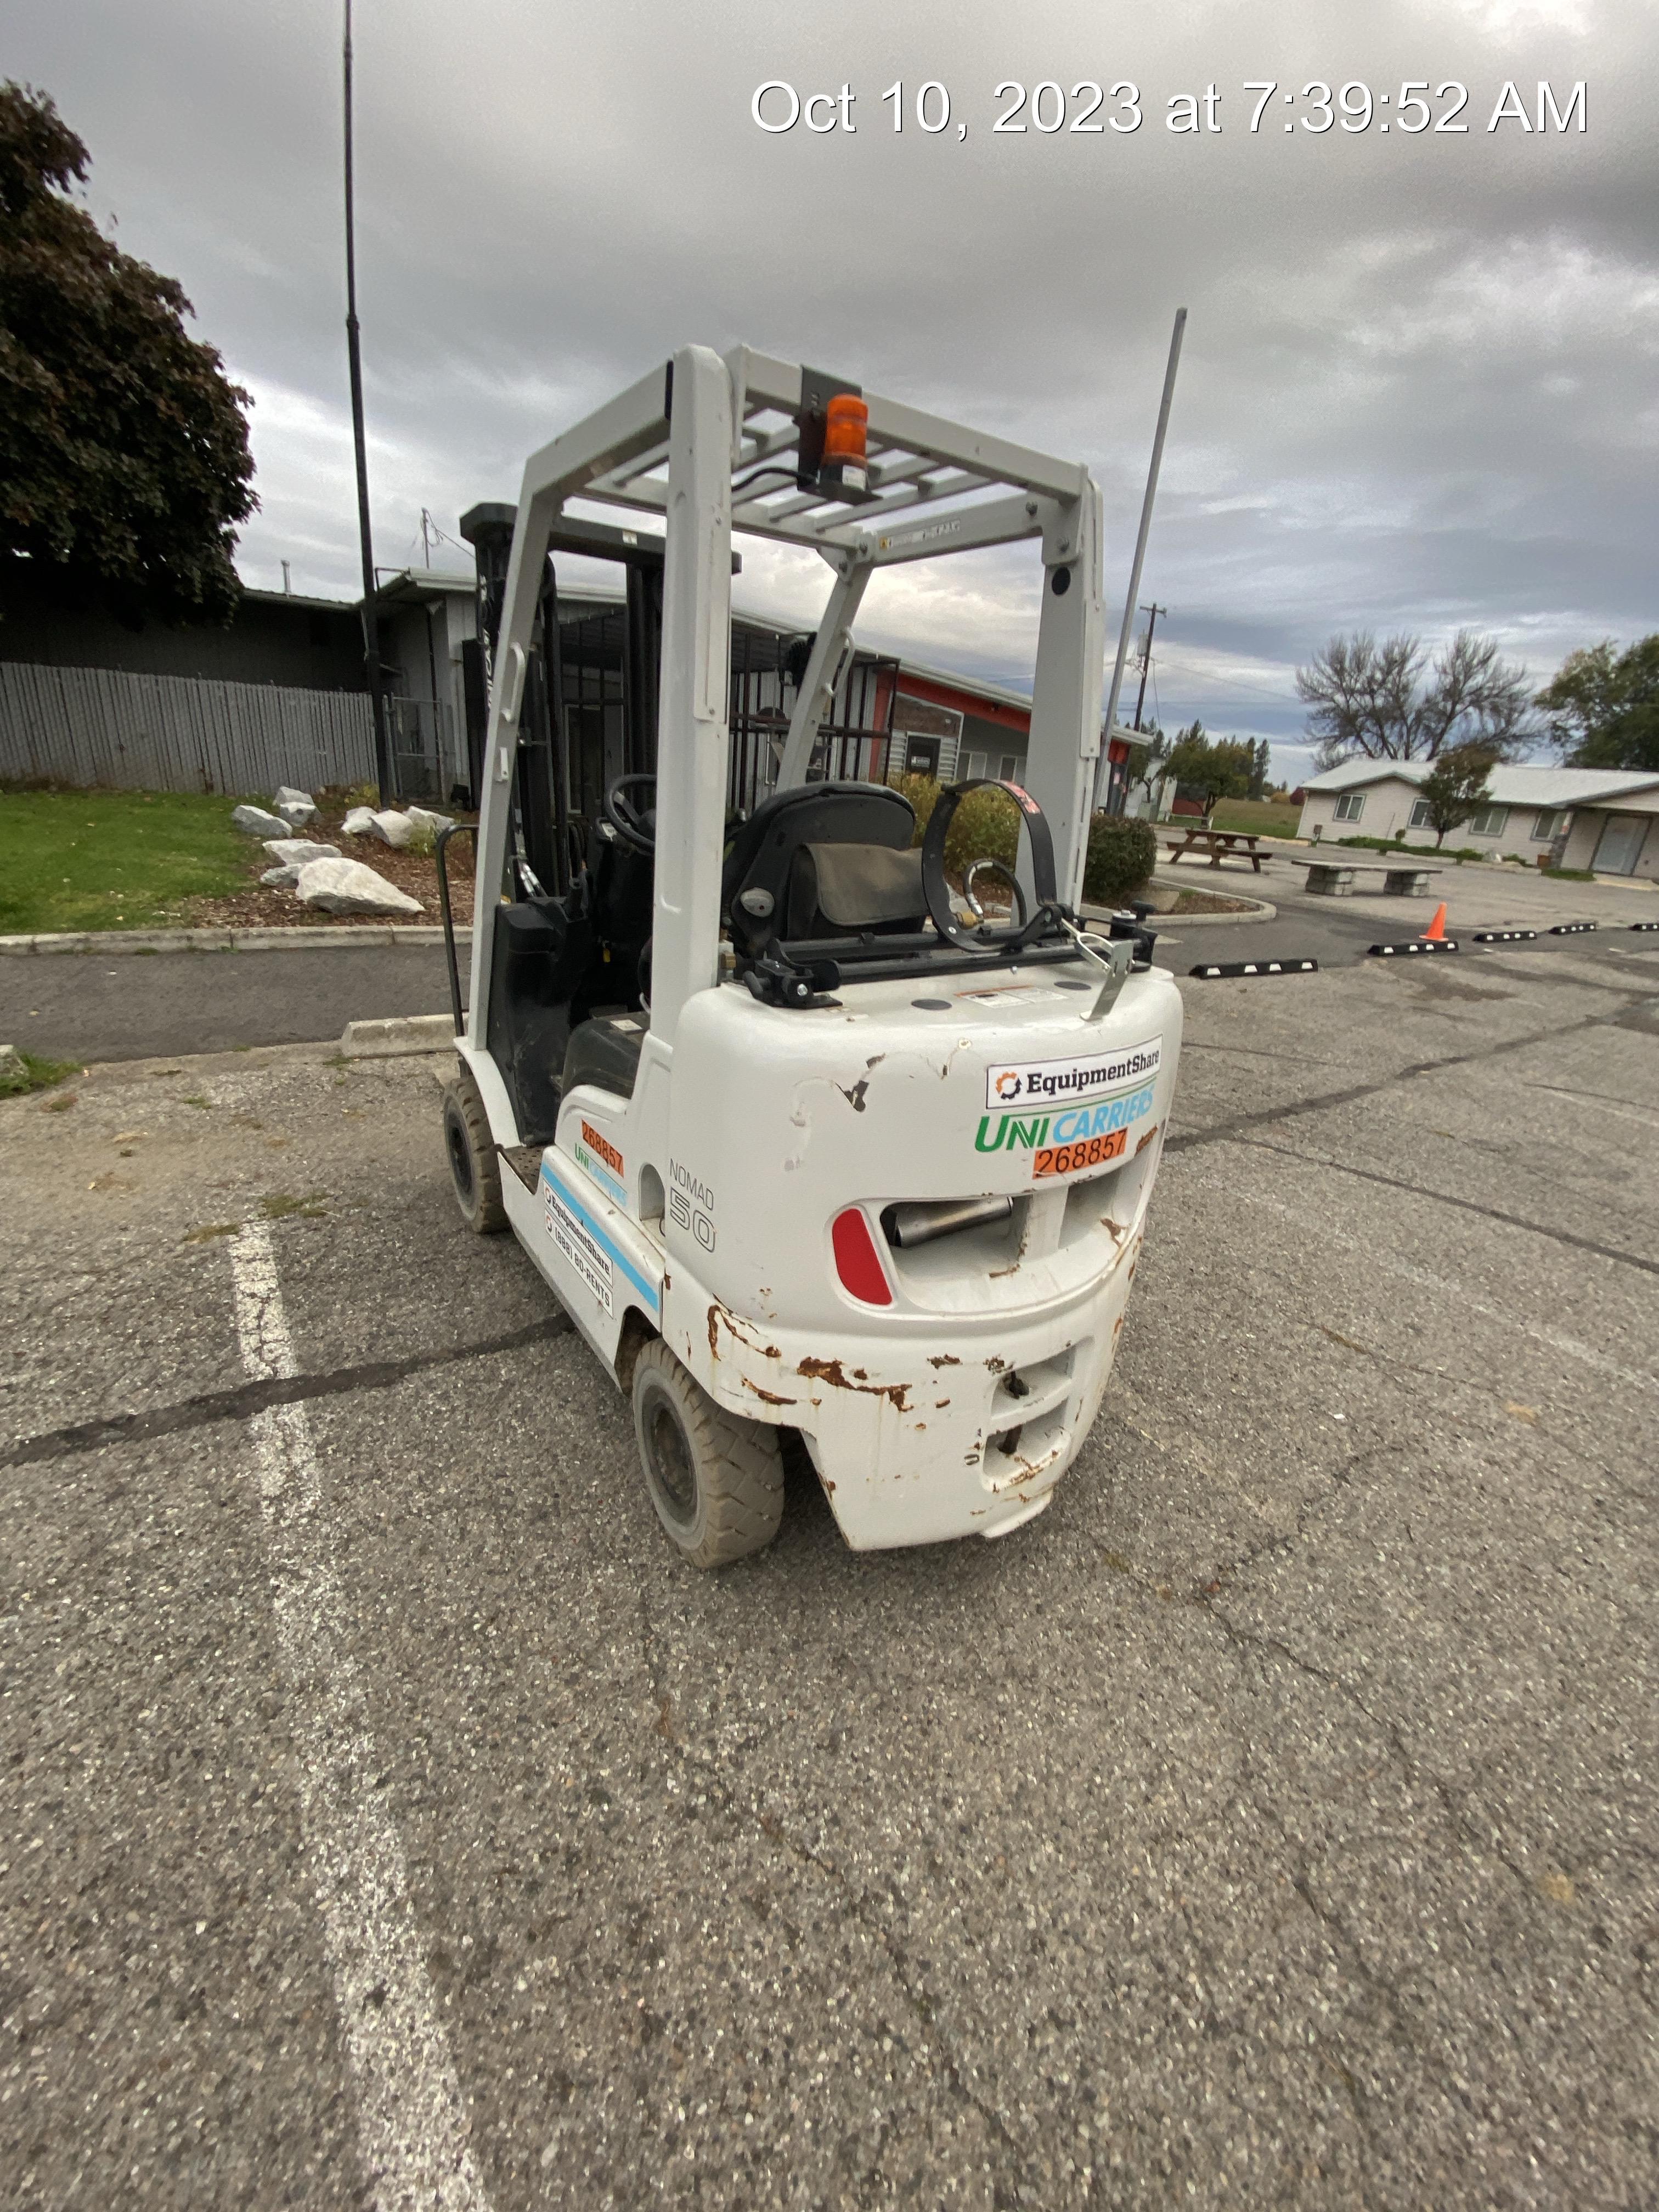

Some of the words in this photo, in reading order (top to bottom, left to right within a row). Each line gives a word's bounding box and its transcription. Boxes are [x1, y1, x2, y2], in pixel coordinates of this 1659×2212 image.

[1026, 1049, 1159, 1096] EquipmentShare
[583, 1121, 623, 1174] 268857
[1035, 1129, 1127, 1178] 268857
[670, 1158, 714, 1211] NOMAD
[551, 1194, 611, 1276] EquipmentShare
[555, 1226, 573, 1260] (888)
[670, 1186, 715, 1253] 50
